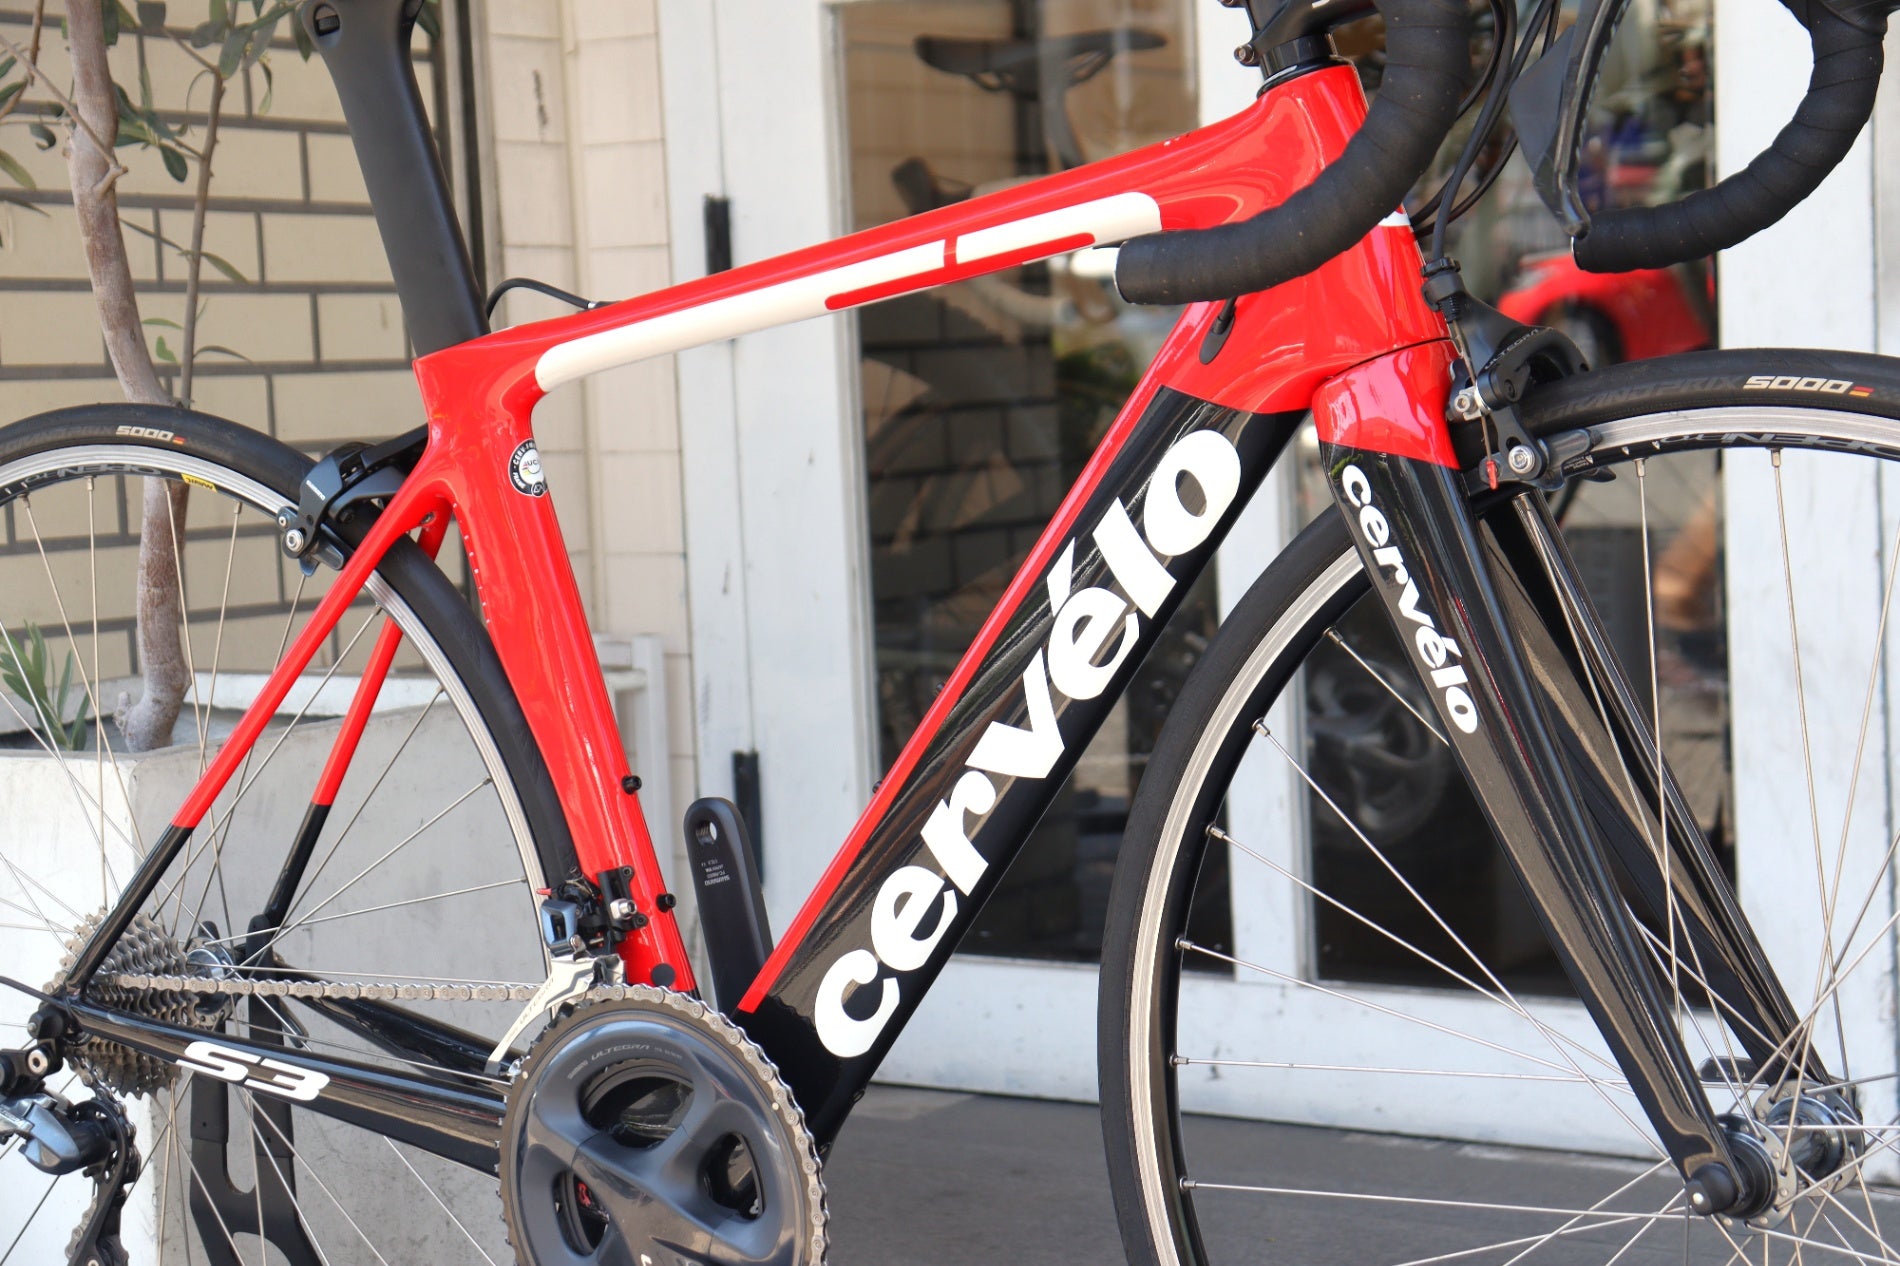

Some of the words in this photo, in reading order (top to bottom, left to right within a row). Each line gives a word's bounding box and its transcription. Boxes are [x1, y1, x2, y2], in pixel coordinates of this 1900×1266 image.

[1742, 375, 1854, 394] 5000
[115, 424, 175, 442] 5000
[1341, 464, 1480, 736] cervélo
[814, 429, 1242, 1059] cervélo
[175, 1041, 331, 1101] S3
[591, 1043, 651, 1061] ULTEGRA
